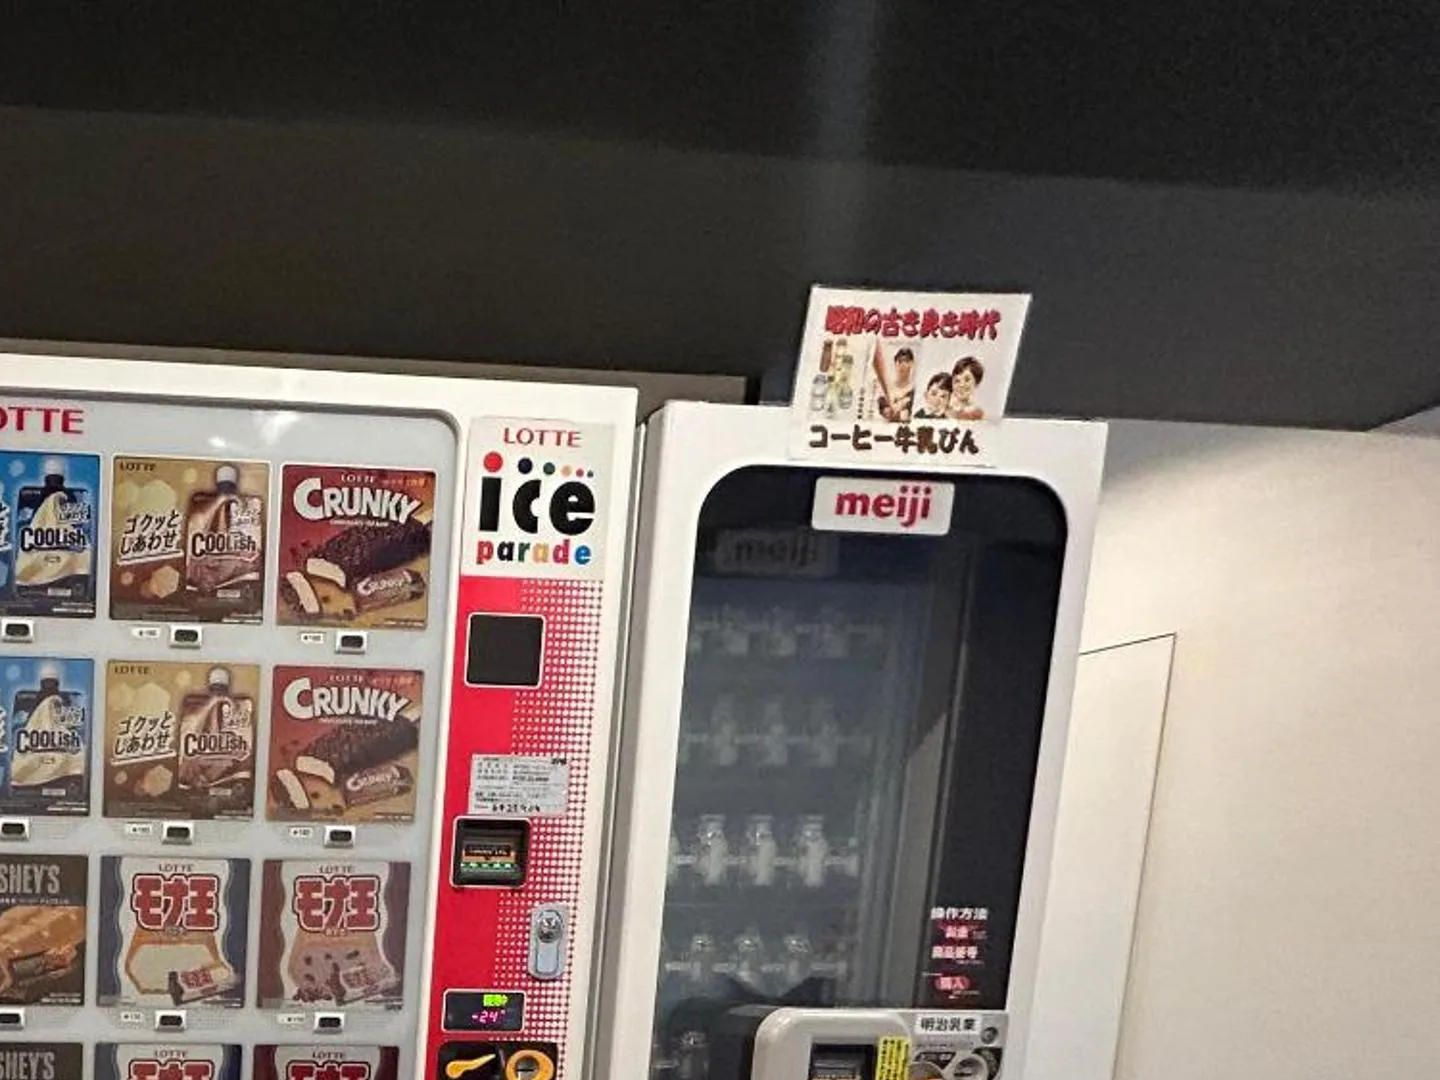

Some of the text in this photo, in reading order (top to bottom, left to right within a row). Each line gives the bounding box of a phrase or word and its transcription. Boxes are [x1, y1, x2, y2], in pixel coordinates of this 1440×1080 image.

[503, 427, 582, 448] LOTTE
[809, 424, 980, 454] コーヒー牛乳びん
[293, 477, 422, 524] CRUNKY
[478, 451, 595, 536] ice
[835, 485, 933, 527] meiji
[476, 539, 592, 565] parade
[283, 677, 409, 722] CRUNKY
[132, 874, 220, 930] モナ王
[293, 876, 380, 932] モナ王
[920, 1017, 977, 1032] 明治乳業
